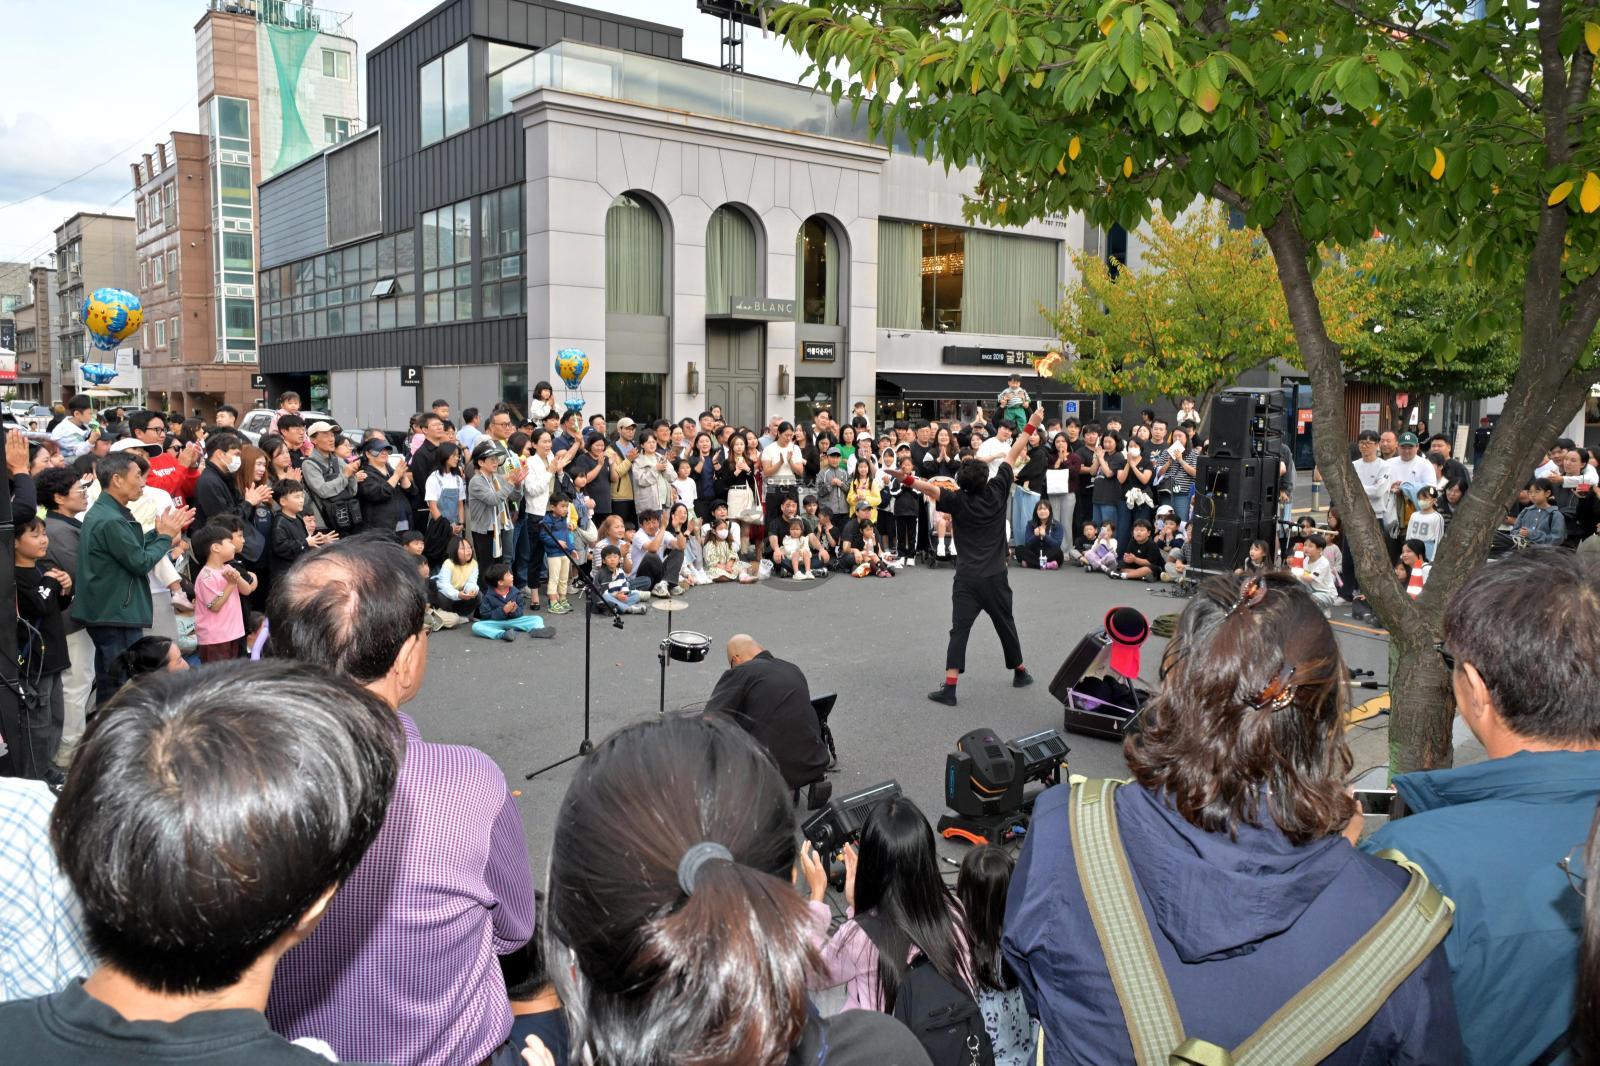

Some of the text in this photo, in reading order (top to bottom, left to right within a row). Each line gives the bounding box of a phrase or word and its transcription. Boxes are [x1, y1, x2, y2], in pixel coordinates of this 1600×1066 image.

[754, 302, 793, 313] BLANC
[408, 368, 416, 379] P
[256, 375, 263, 384] P
[1412, 521, 1430, 536] 98
